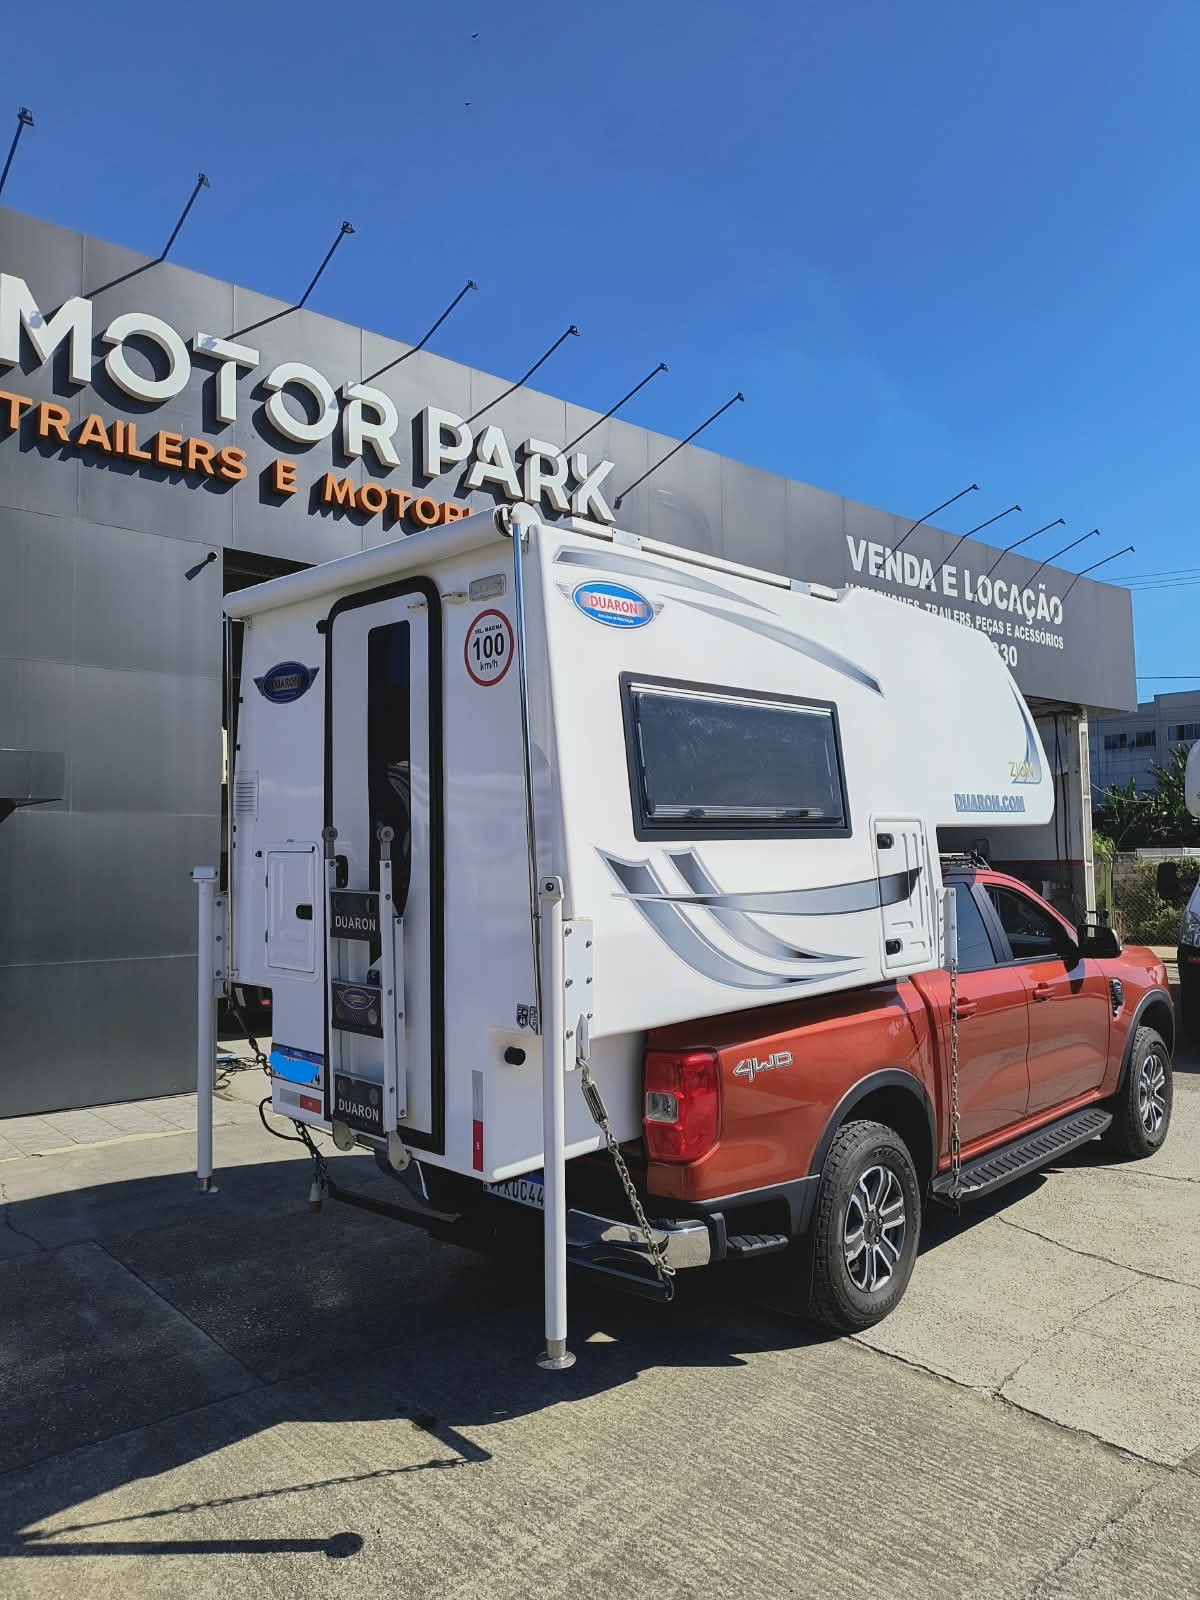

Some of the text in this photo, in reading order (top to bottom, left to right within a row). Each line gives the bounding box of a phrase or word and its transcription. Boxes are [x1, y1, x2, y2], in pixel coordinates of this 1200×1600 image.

[0, 272, 616, 524] MOTOR PARK
[0, 390, 474, 531] TRAILERS E MOTOR
[846, 534, 937, 593] VENDA
[942, 565, 958, 598] E
[964, 569, 1064, 625] LOCAÇÃO
[589, 594, 638, 615] DUARON
[472, 632, 505, 661] 100
[976, 616, 1004, 636] PEÇAS
[1006, 623, 1013, 638] E
[1014, 624, 1064, 650] ACESSÓRIOS
[479, 658, 499, 672] km/h
[953, 793, 1025, 812] DUARON.COM
[335, 915, 376, 932] DUARON
[732, 1050, 794, 1082] 4WD
[338, 1098, 380, 1122] DUARON
